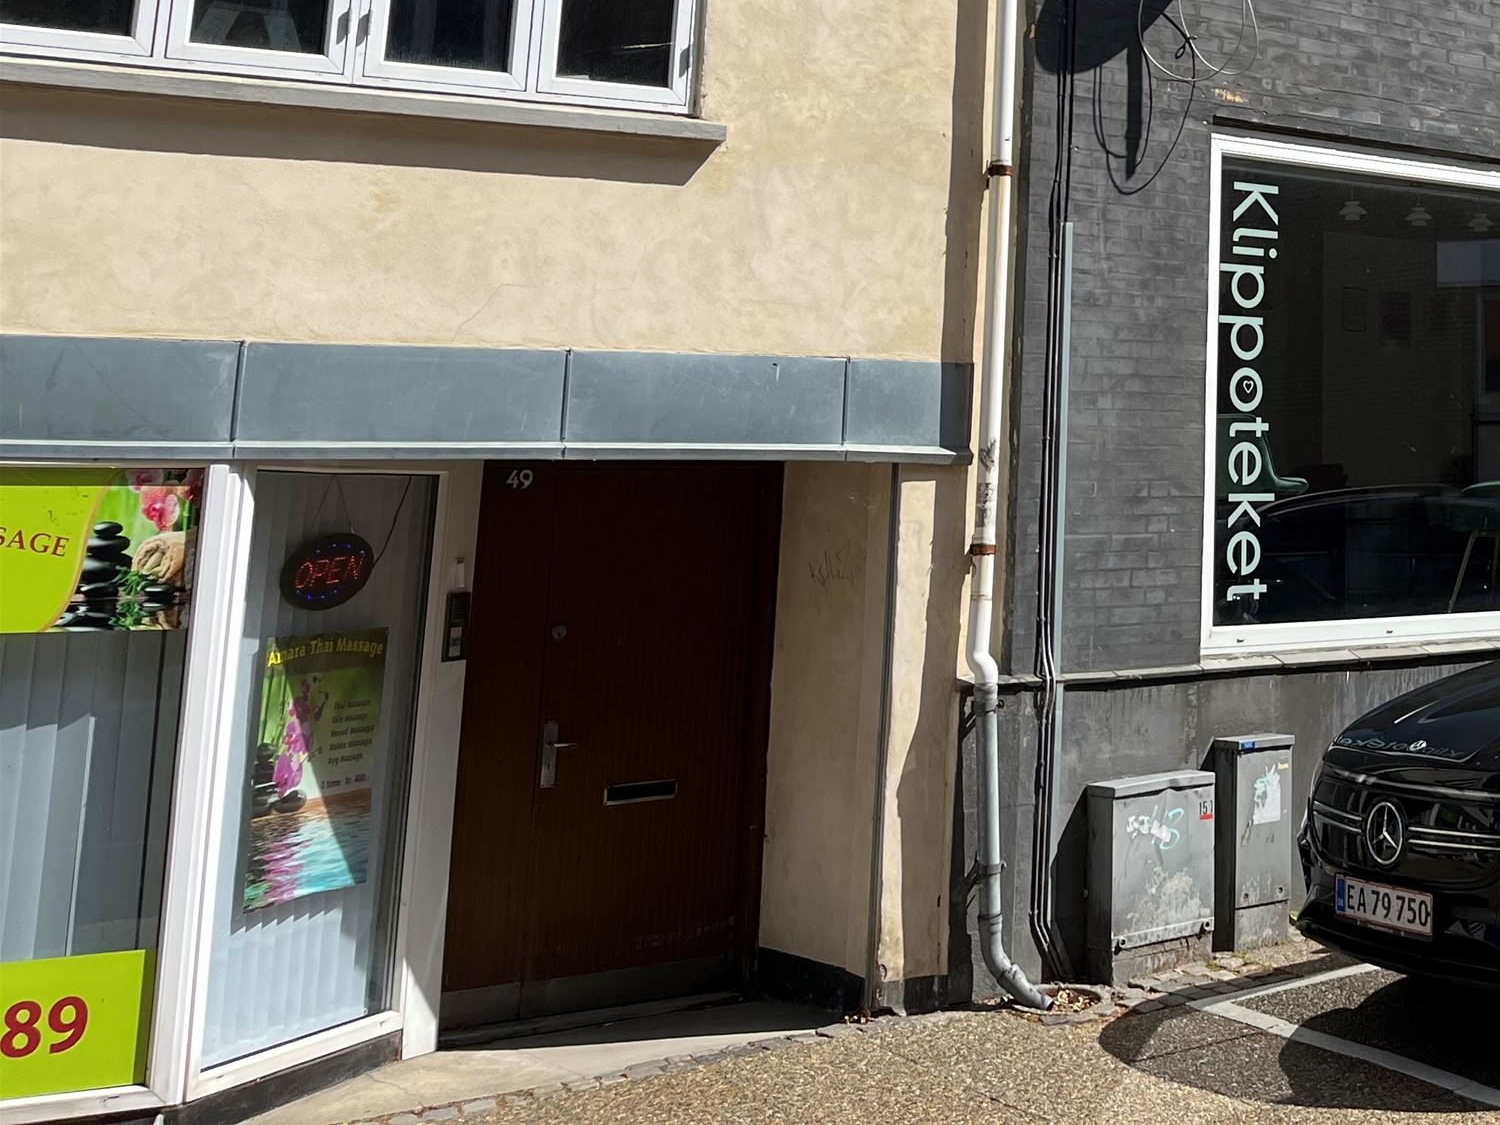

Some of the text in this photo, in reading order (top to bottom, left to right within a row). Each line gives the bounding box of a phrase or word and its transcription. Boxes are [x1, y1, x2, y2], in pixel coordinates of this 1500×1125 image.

[1219, 181, 1279, 602] Klippoteket
[506, 469, 533, 489] 49
[294, 556, 366, 588] OPEN
[309, 637, 334, 656] Thai
[336, 636, 384, 658] Massage
[1347, 884, 1428, 927] EA 79 750
[0, 995, 89, 1058] 89
